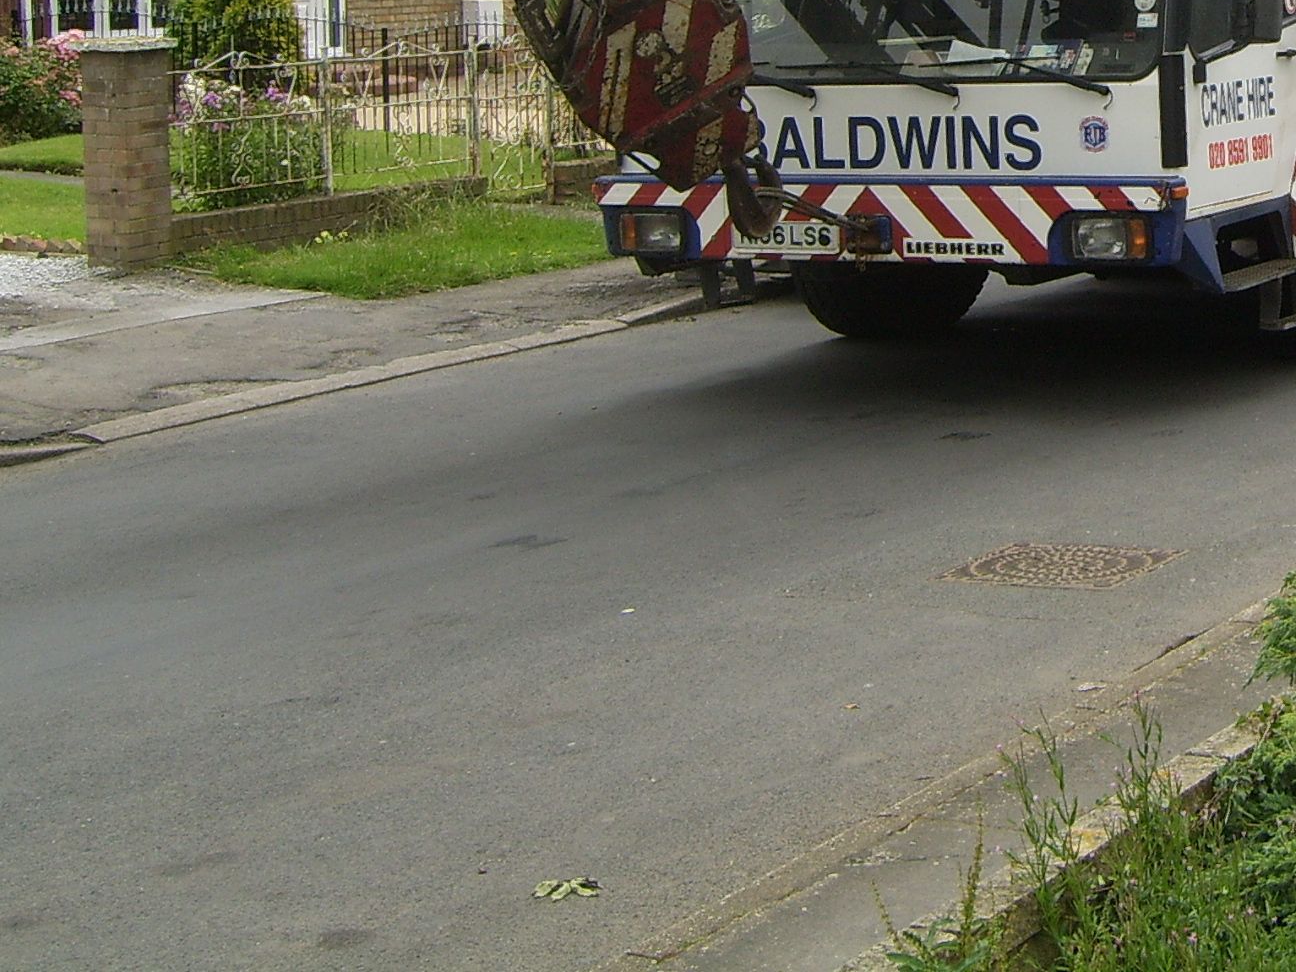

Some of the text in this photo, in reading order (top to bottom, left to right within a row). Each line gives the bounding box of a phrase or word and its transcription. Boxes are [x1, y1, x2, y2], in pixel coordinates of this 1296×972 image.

[1201, 76, 1276, 128] CRANE HIRE
[1208, 134, 1273, 169] 020 8591 9901
[906, 241, 1005, 255] LIEBHERR
